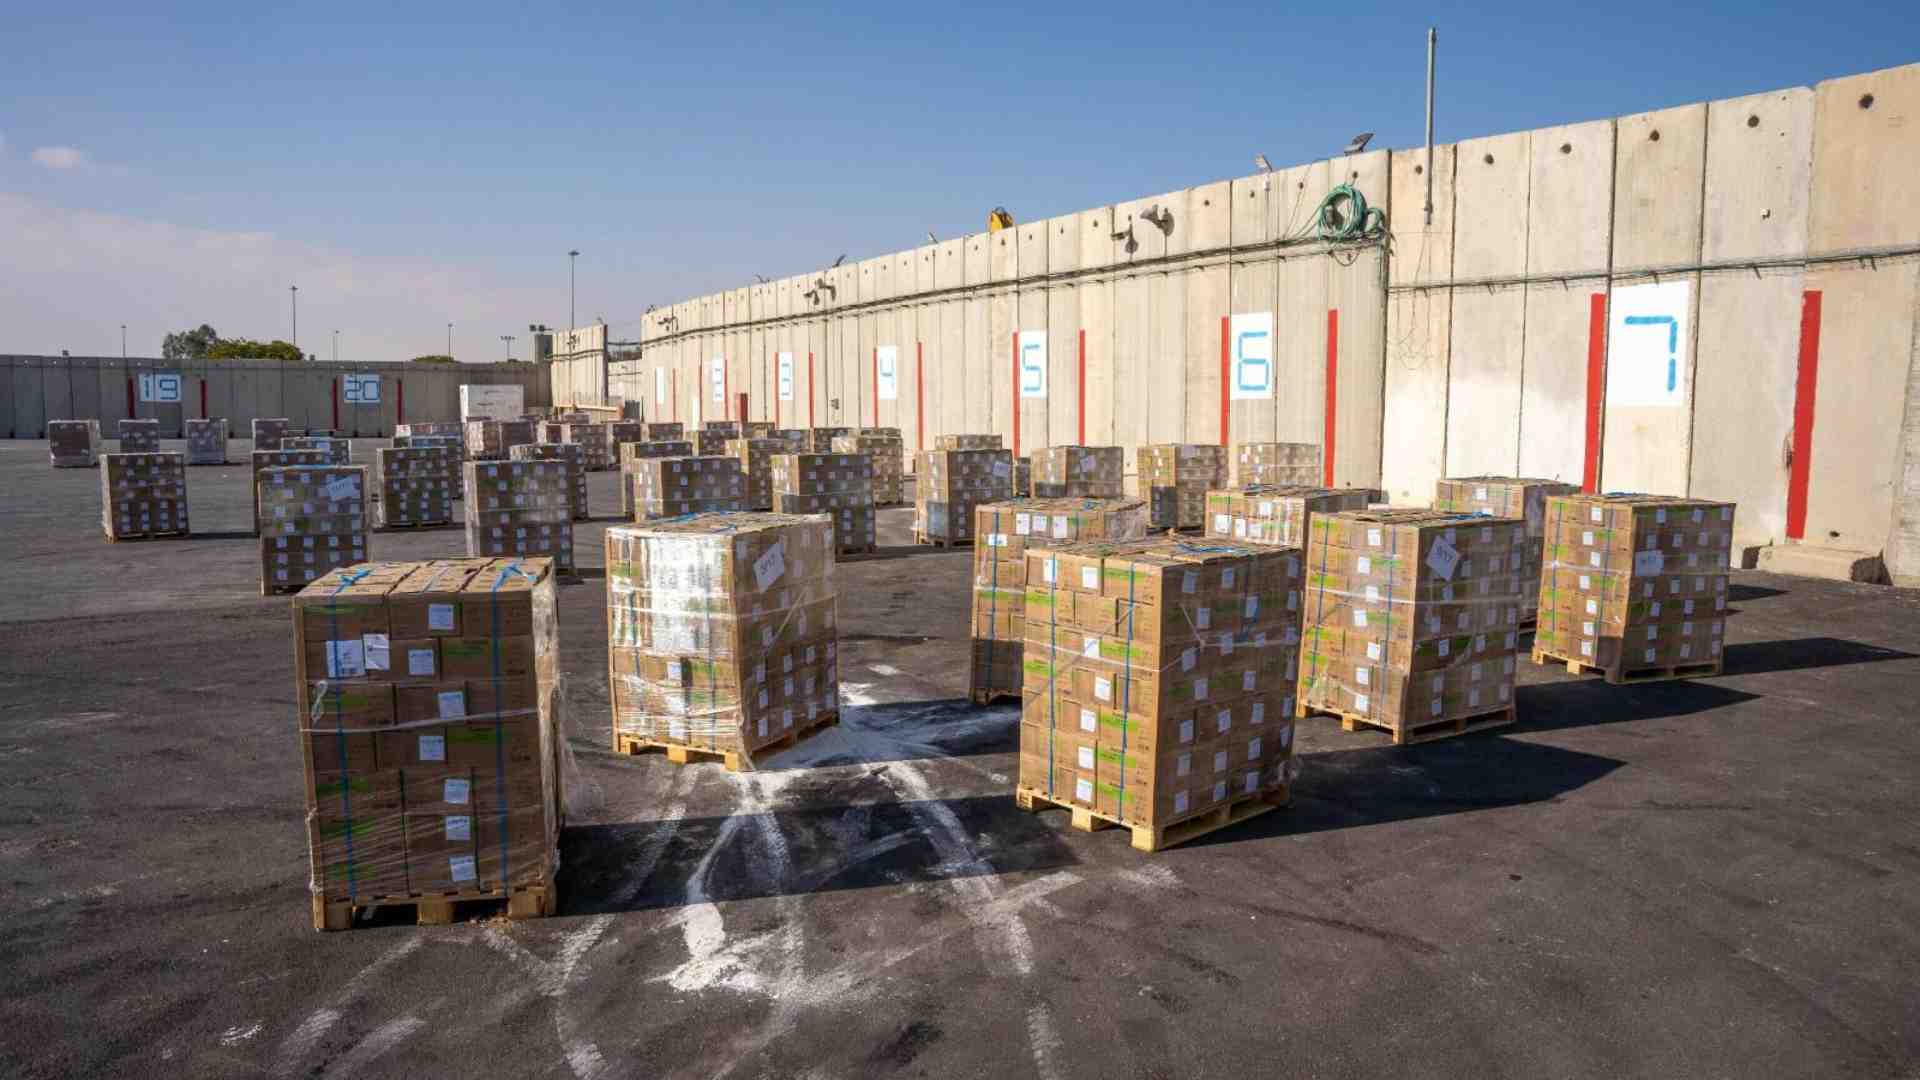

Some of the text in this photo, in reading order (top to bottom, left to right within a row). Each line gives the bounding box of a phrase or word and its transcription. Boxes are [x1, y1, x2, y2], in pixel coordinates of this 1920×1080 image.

[879, 355, 895, 391] 4
[1021, 343, 1043, 393] 5
[1237, 330, 1270, 391] 6
[1624, 315, 1678, 392] 7
[144, 379, 178, 400] 19
[344, 379, 380, 401] 20
